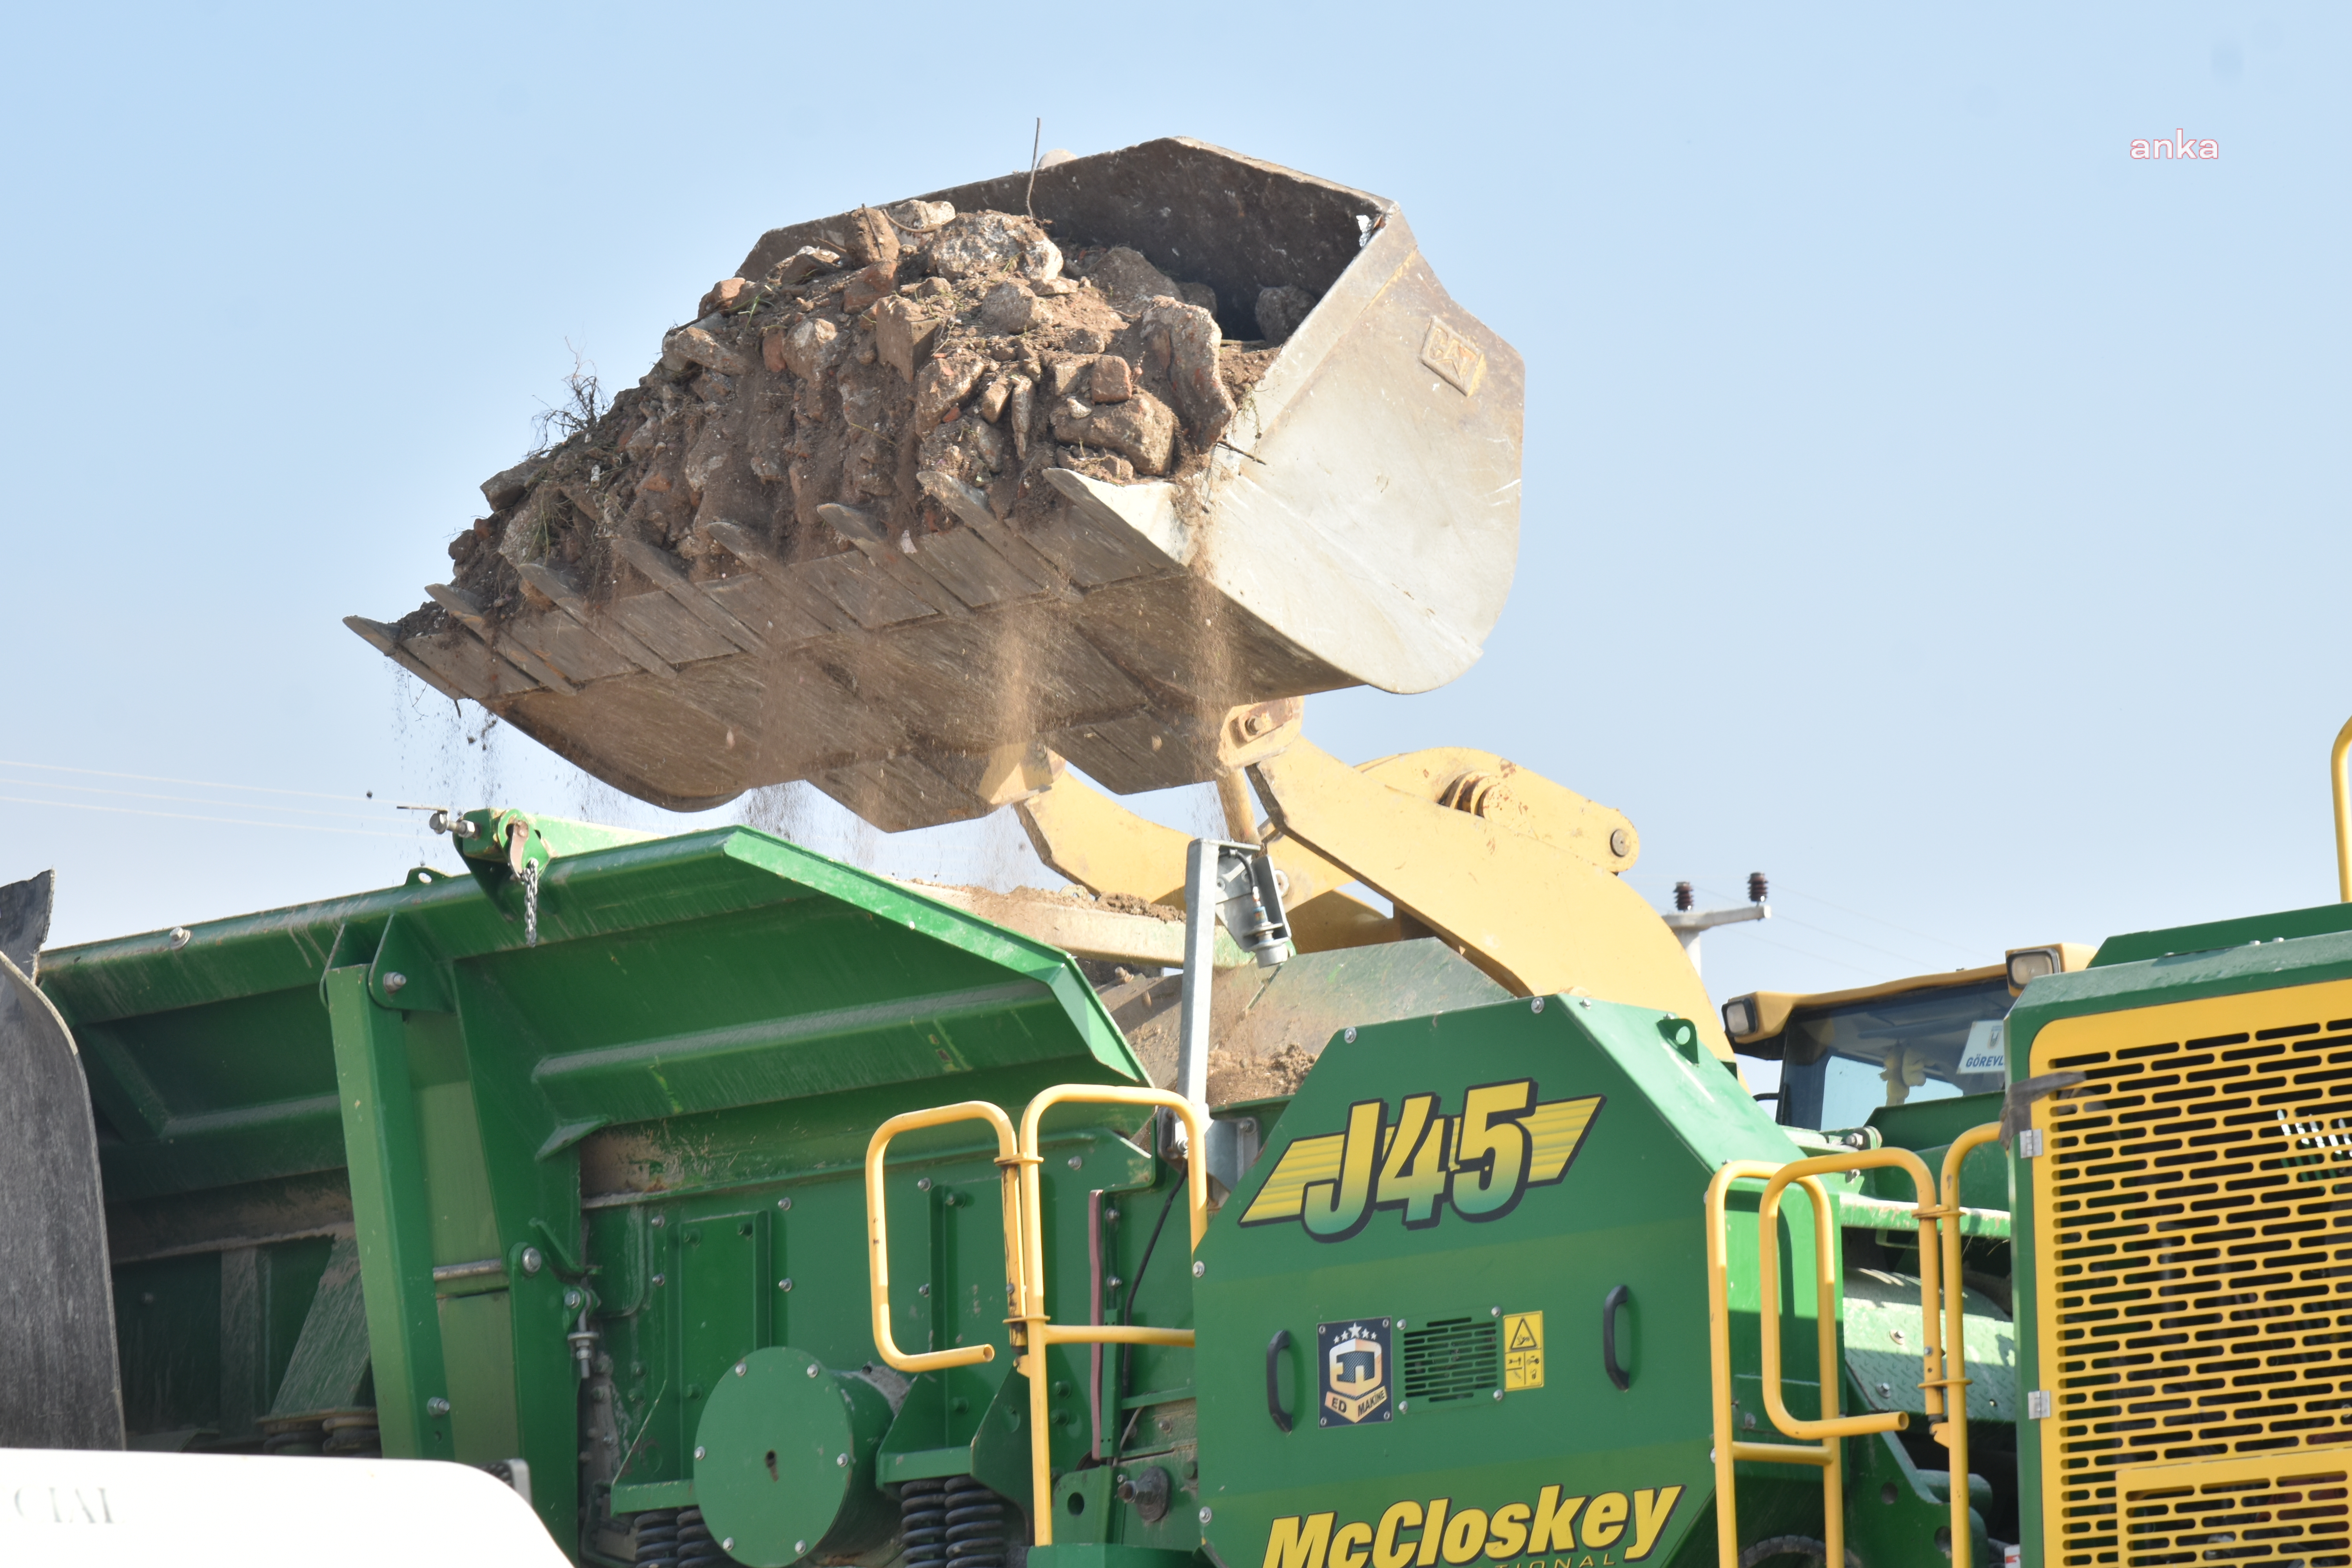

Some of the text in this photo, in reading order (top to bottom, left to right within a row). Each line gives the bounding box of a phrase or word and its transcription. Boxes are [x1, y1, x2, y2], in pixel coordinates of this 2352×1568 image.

[1427, 327, 1477, 382] CAT
[1965, 1053, 2005, 1067] GÖREVL
[1301, 1077, 1538, 1243] J45
[1331, 1390, 1385, 1417] ED MAKİNE
[1261, 1483, 1686, 1568] McCloskey
